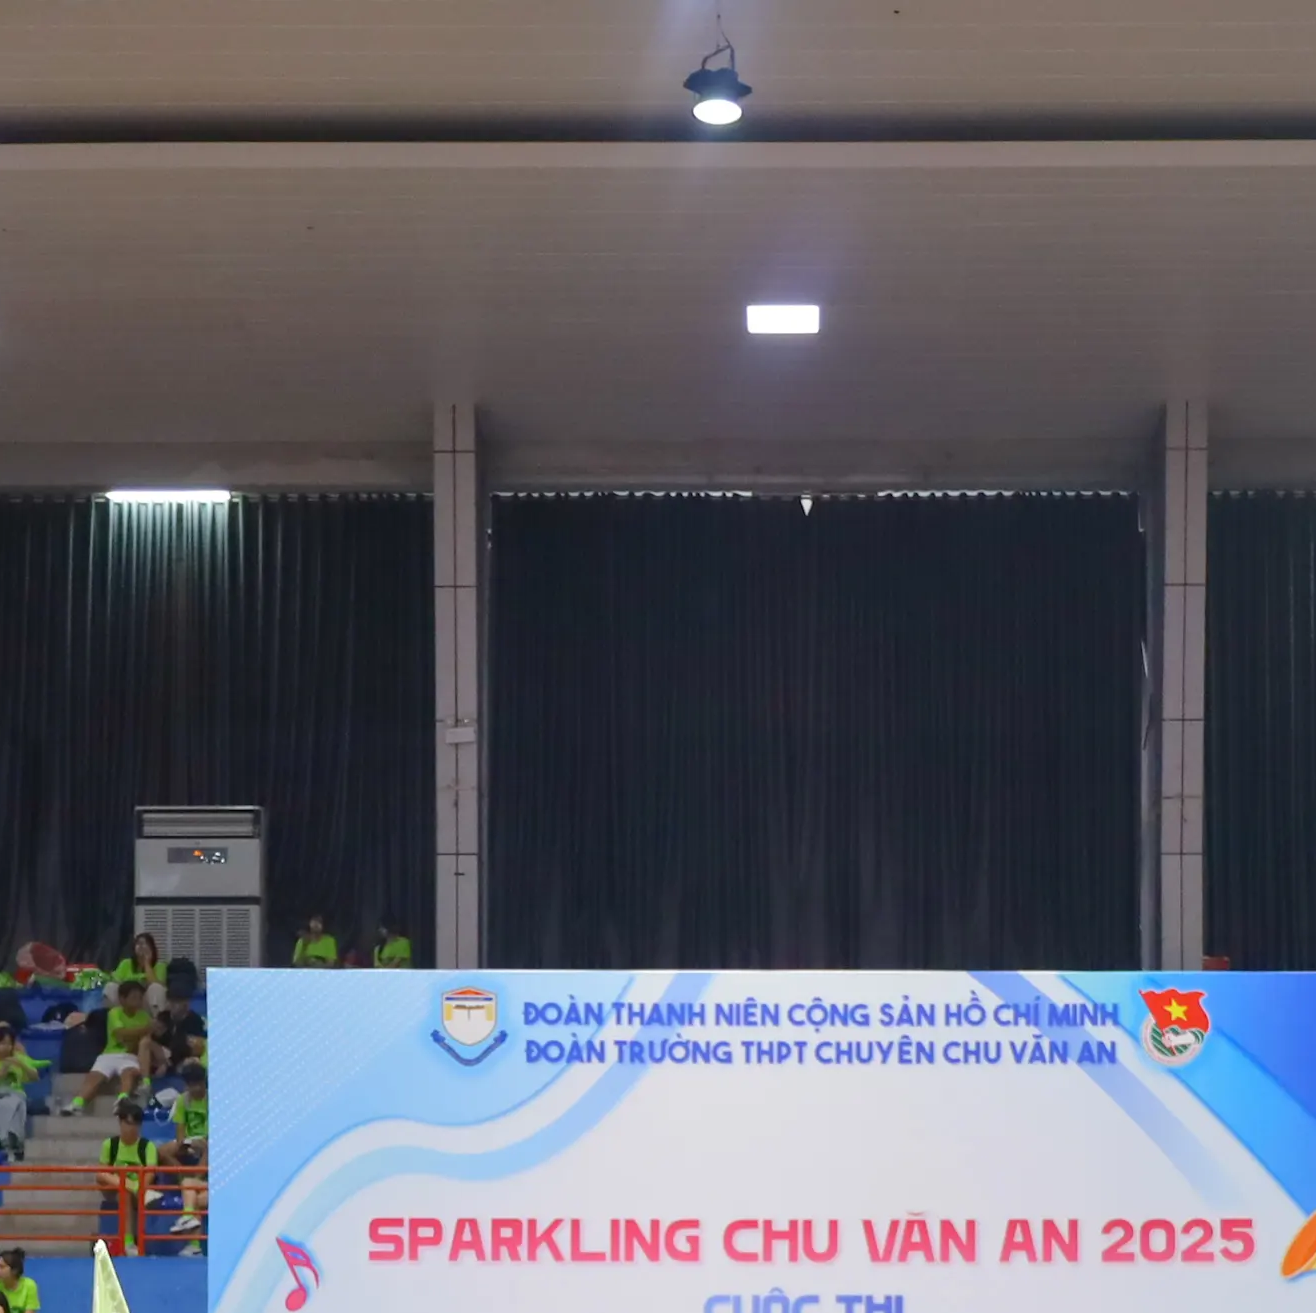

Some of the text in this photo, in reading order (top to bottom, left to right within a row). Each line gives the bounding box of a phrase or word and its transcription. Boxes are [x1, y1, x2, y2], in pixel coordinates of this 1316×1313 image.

[523, 990, 1119, 1033] ĐOÀN THANH NIÊN CỘNG SẢN HỒ CHÍ MINH
[525, 1030, 1117, 1064] ĐOÀN TRƯỜNG THPT CHUYÊN CHU VĂN AN
[368, 1212, 1255, 1262] SPARKLING CHU VĂN AN 2025
